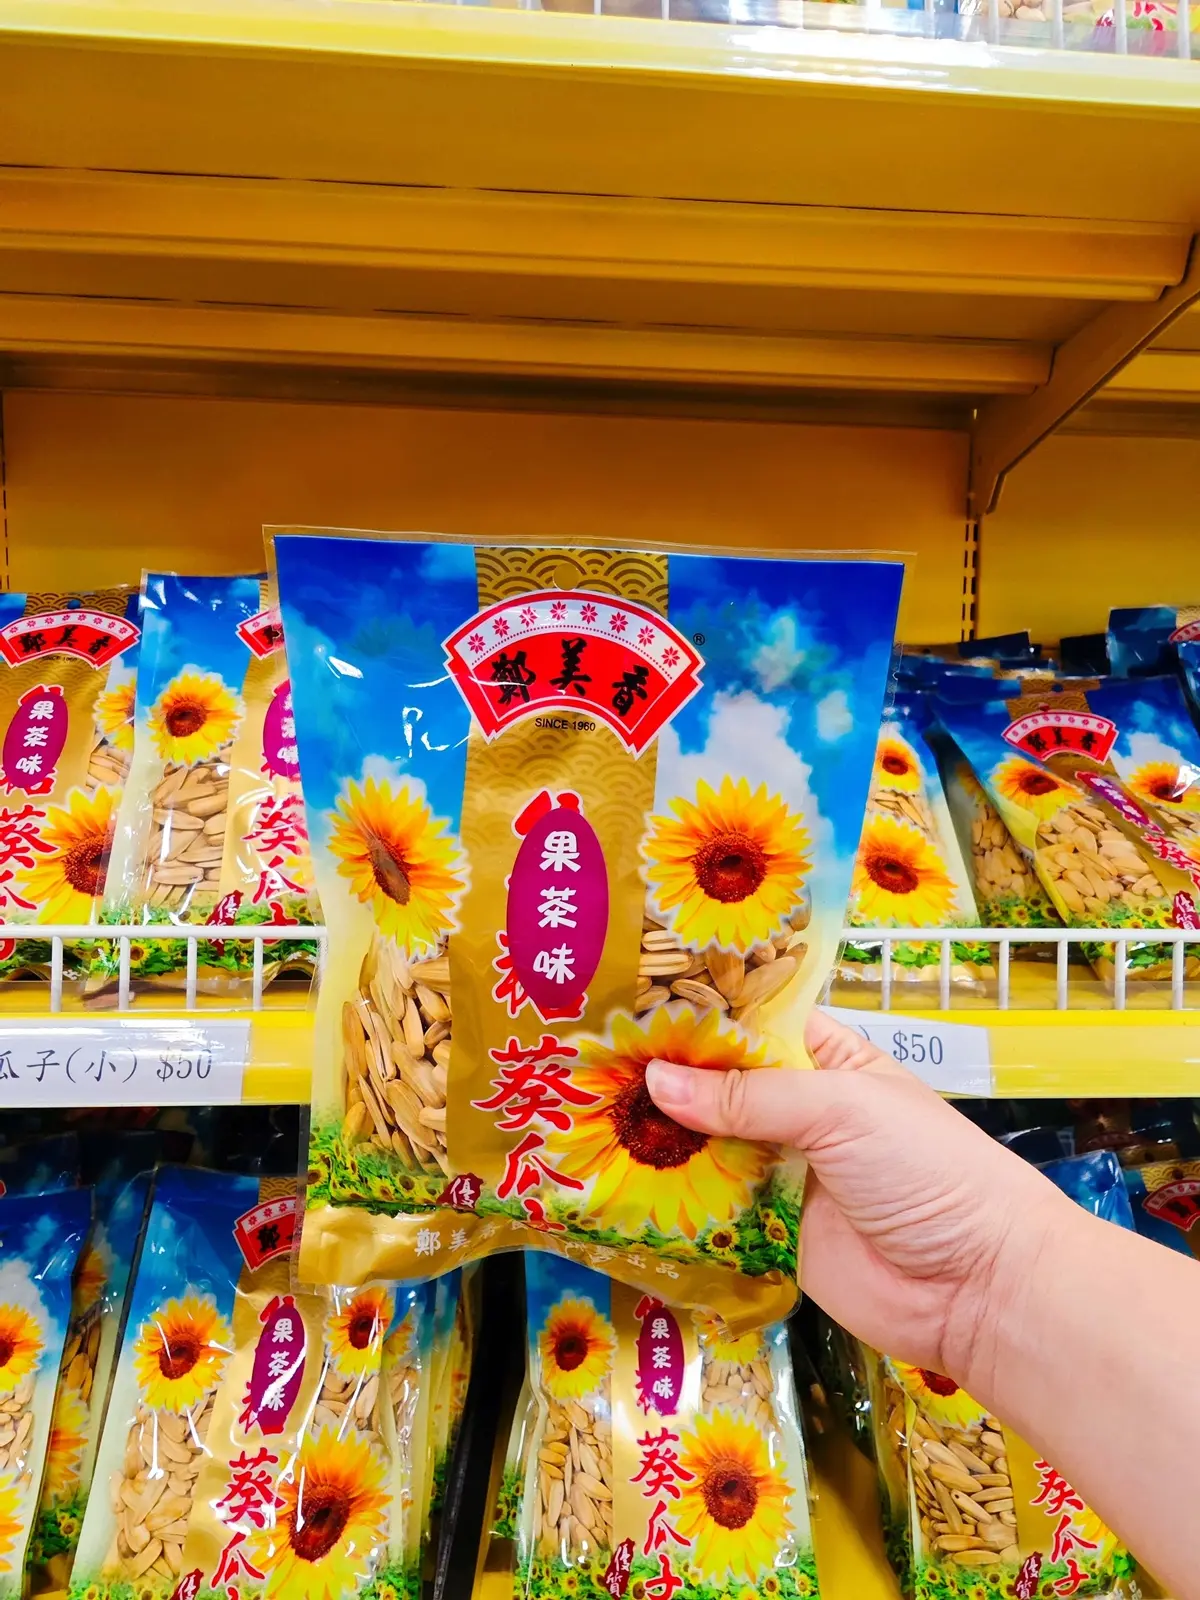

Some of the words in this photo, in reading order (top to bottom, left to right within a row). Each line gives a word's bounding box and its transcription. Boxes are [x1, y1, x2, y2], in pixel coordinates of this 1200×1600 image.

[490, 637, 652, 717] 鄭美香
[15, 700, 55, 775] 果茶味
[534, 717, 569, 731] SINCE
[572, 720, 596, 732] 1960
[532, 830, 582, 985] 果茶味
[157, 1047, 212, 1082] $50
[892, 1029, 944, 1065] $50
[650, 1317, 675, 1399] 果茶味
[628, 1426, 697, 1600] 葵瓜子
[605, 1544, 631, 1598] 優質
